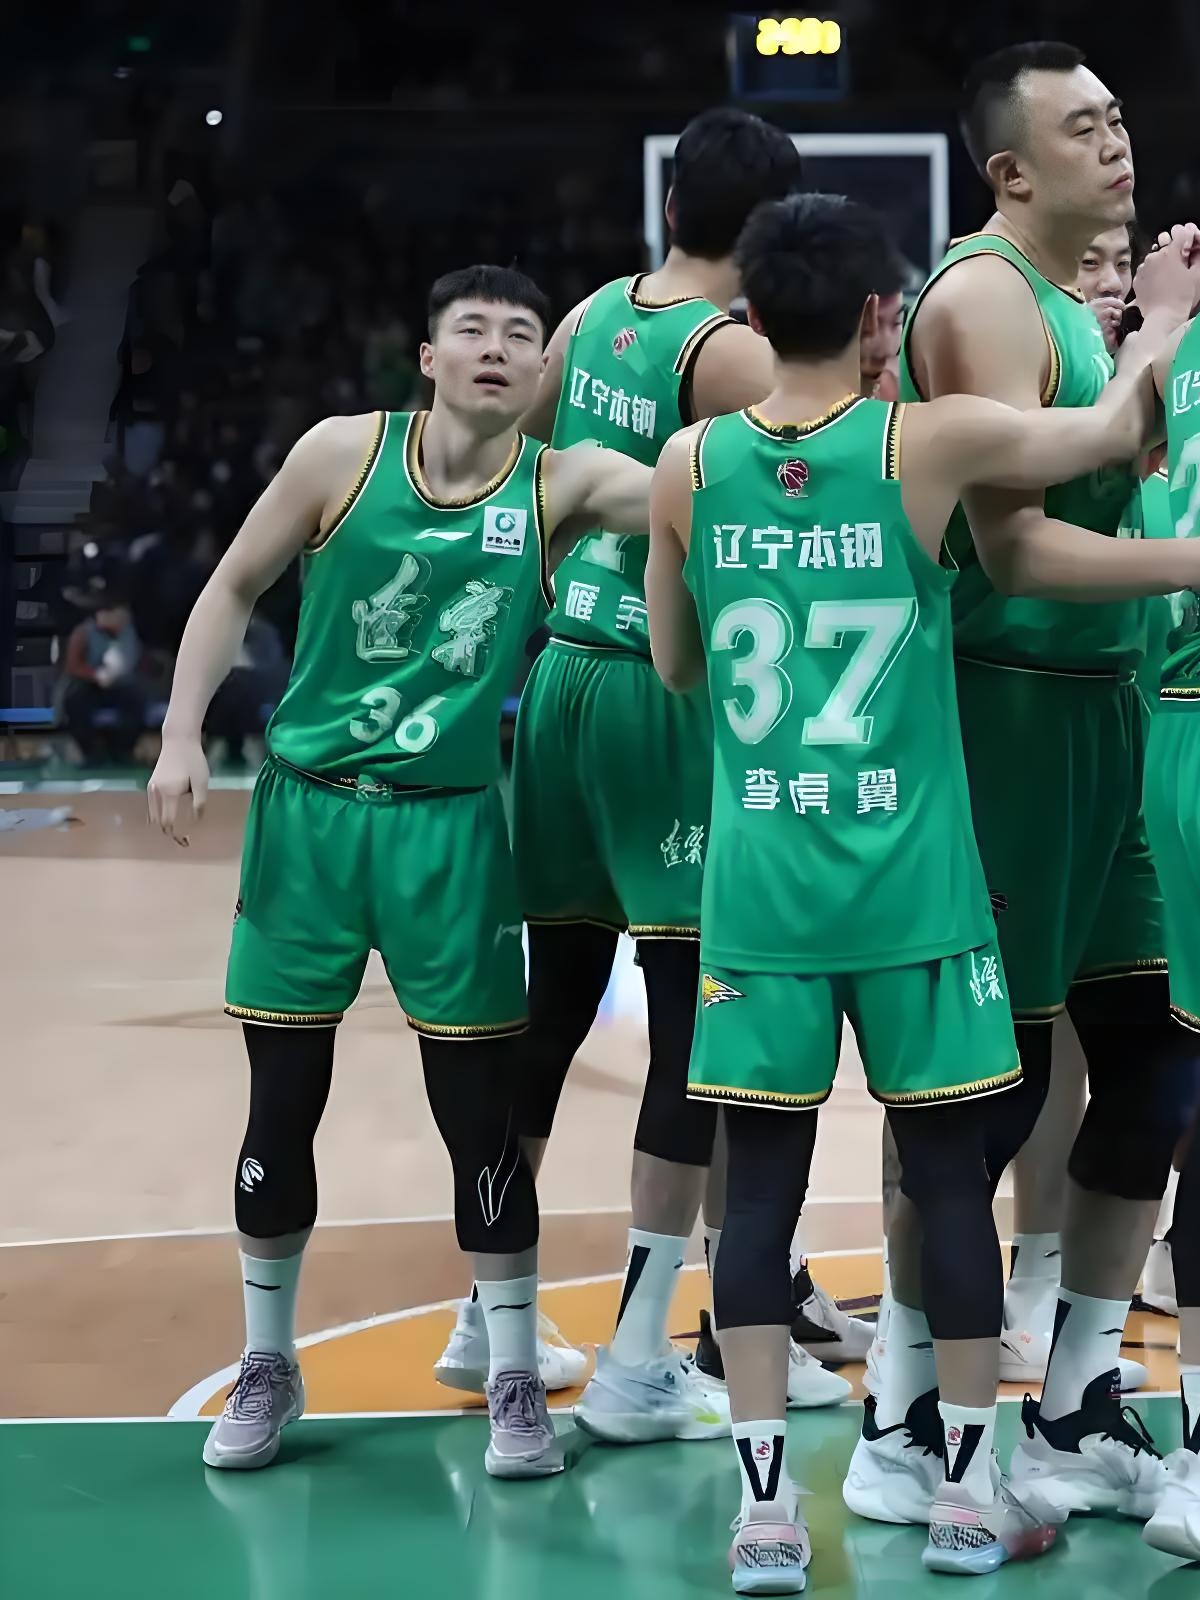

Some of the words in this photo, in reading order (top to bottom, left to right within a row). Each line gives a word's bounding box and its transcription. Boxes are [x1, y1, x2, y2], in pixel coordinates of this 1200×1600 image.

[569, 366, 657, 440] 辽宁本钢
[713, 522, 884, 570] 辽宁本钢
[711, 597, 919, 745] 37
[350, 686, 440, 754] 36
